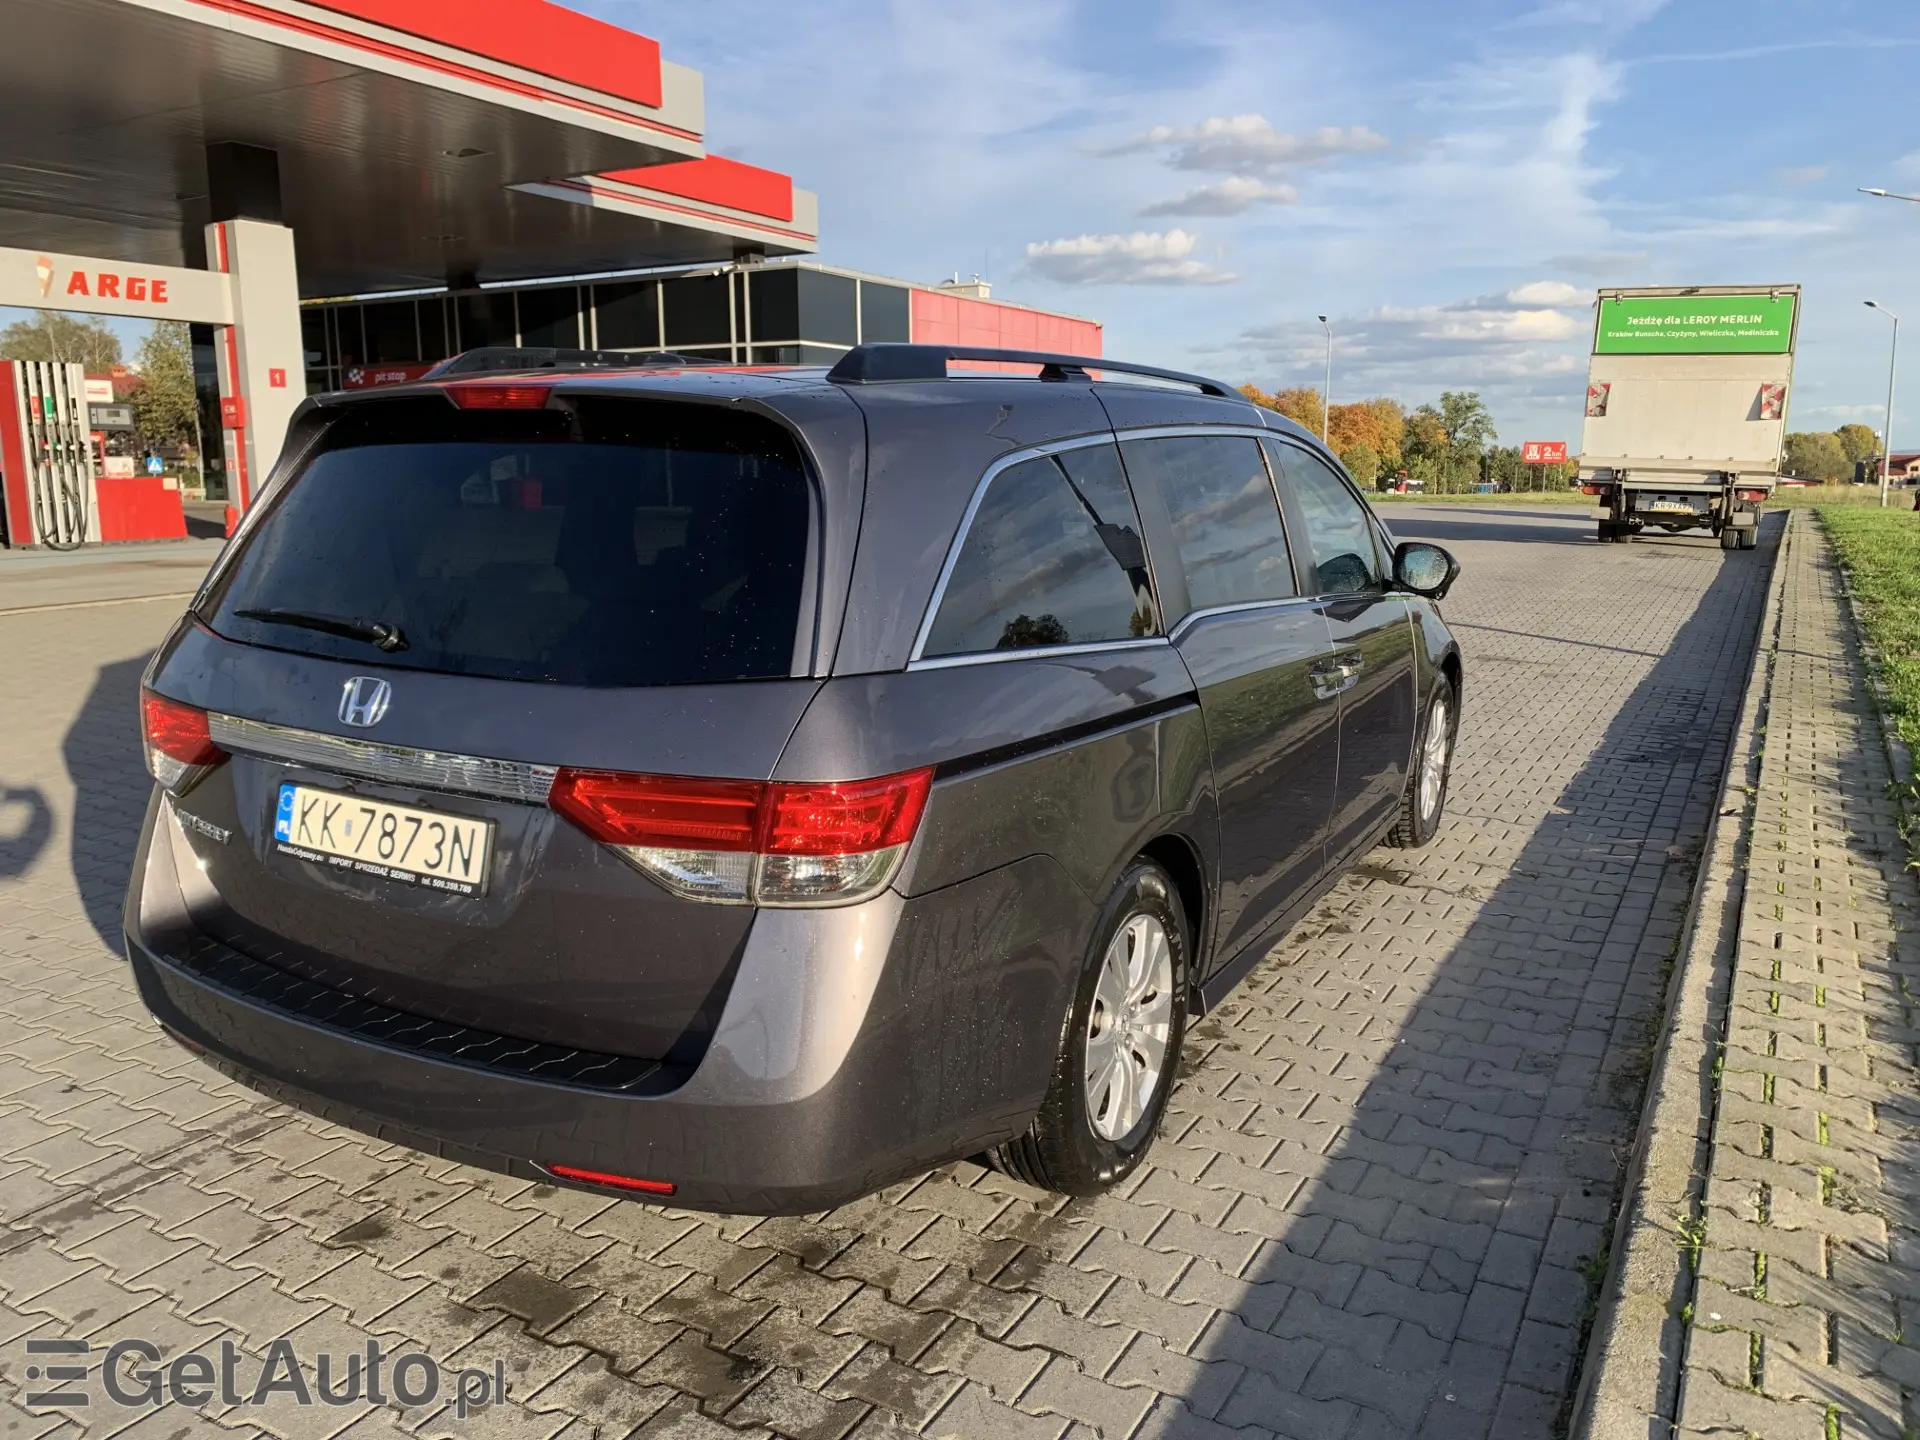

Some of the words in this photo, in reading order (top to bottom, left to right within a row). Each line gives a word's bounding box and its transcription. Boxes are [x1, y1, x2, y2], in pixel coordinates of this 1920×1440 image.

[67, 271, 168, 303] ARGE
[1627, 316, 1662, 327] Jeżdżę
[1664, 316, 1681, 325] dla
[1683, 315, 1718, 325] LEROY
[1720, 314, 1763, 324] MERLIN
[1699, 329, 1736, 337] Wieliczka,
[275, 372, 281, 385] 1
[387, 372, 406, 383] stop
[278, 819, 290, 835] PL
[297, 795, 343, 849] KK
[354, 807, 475, 877] 7873N
[328, 856, 354, 868] IMPORT
[354, 861, 389, 877] SPRZEDAŻ
[389, 869, 416, 883] SERWIS
